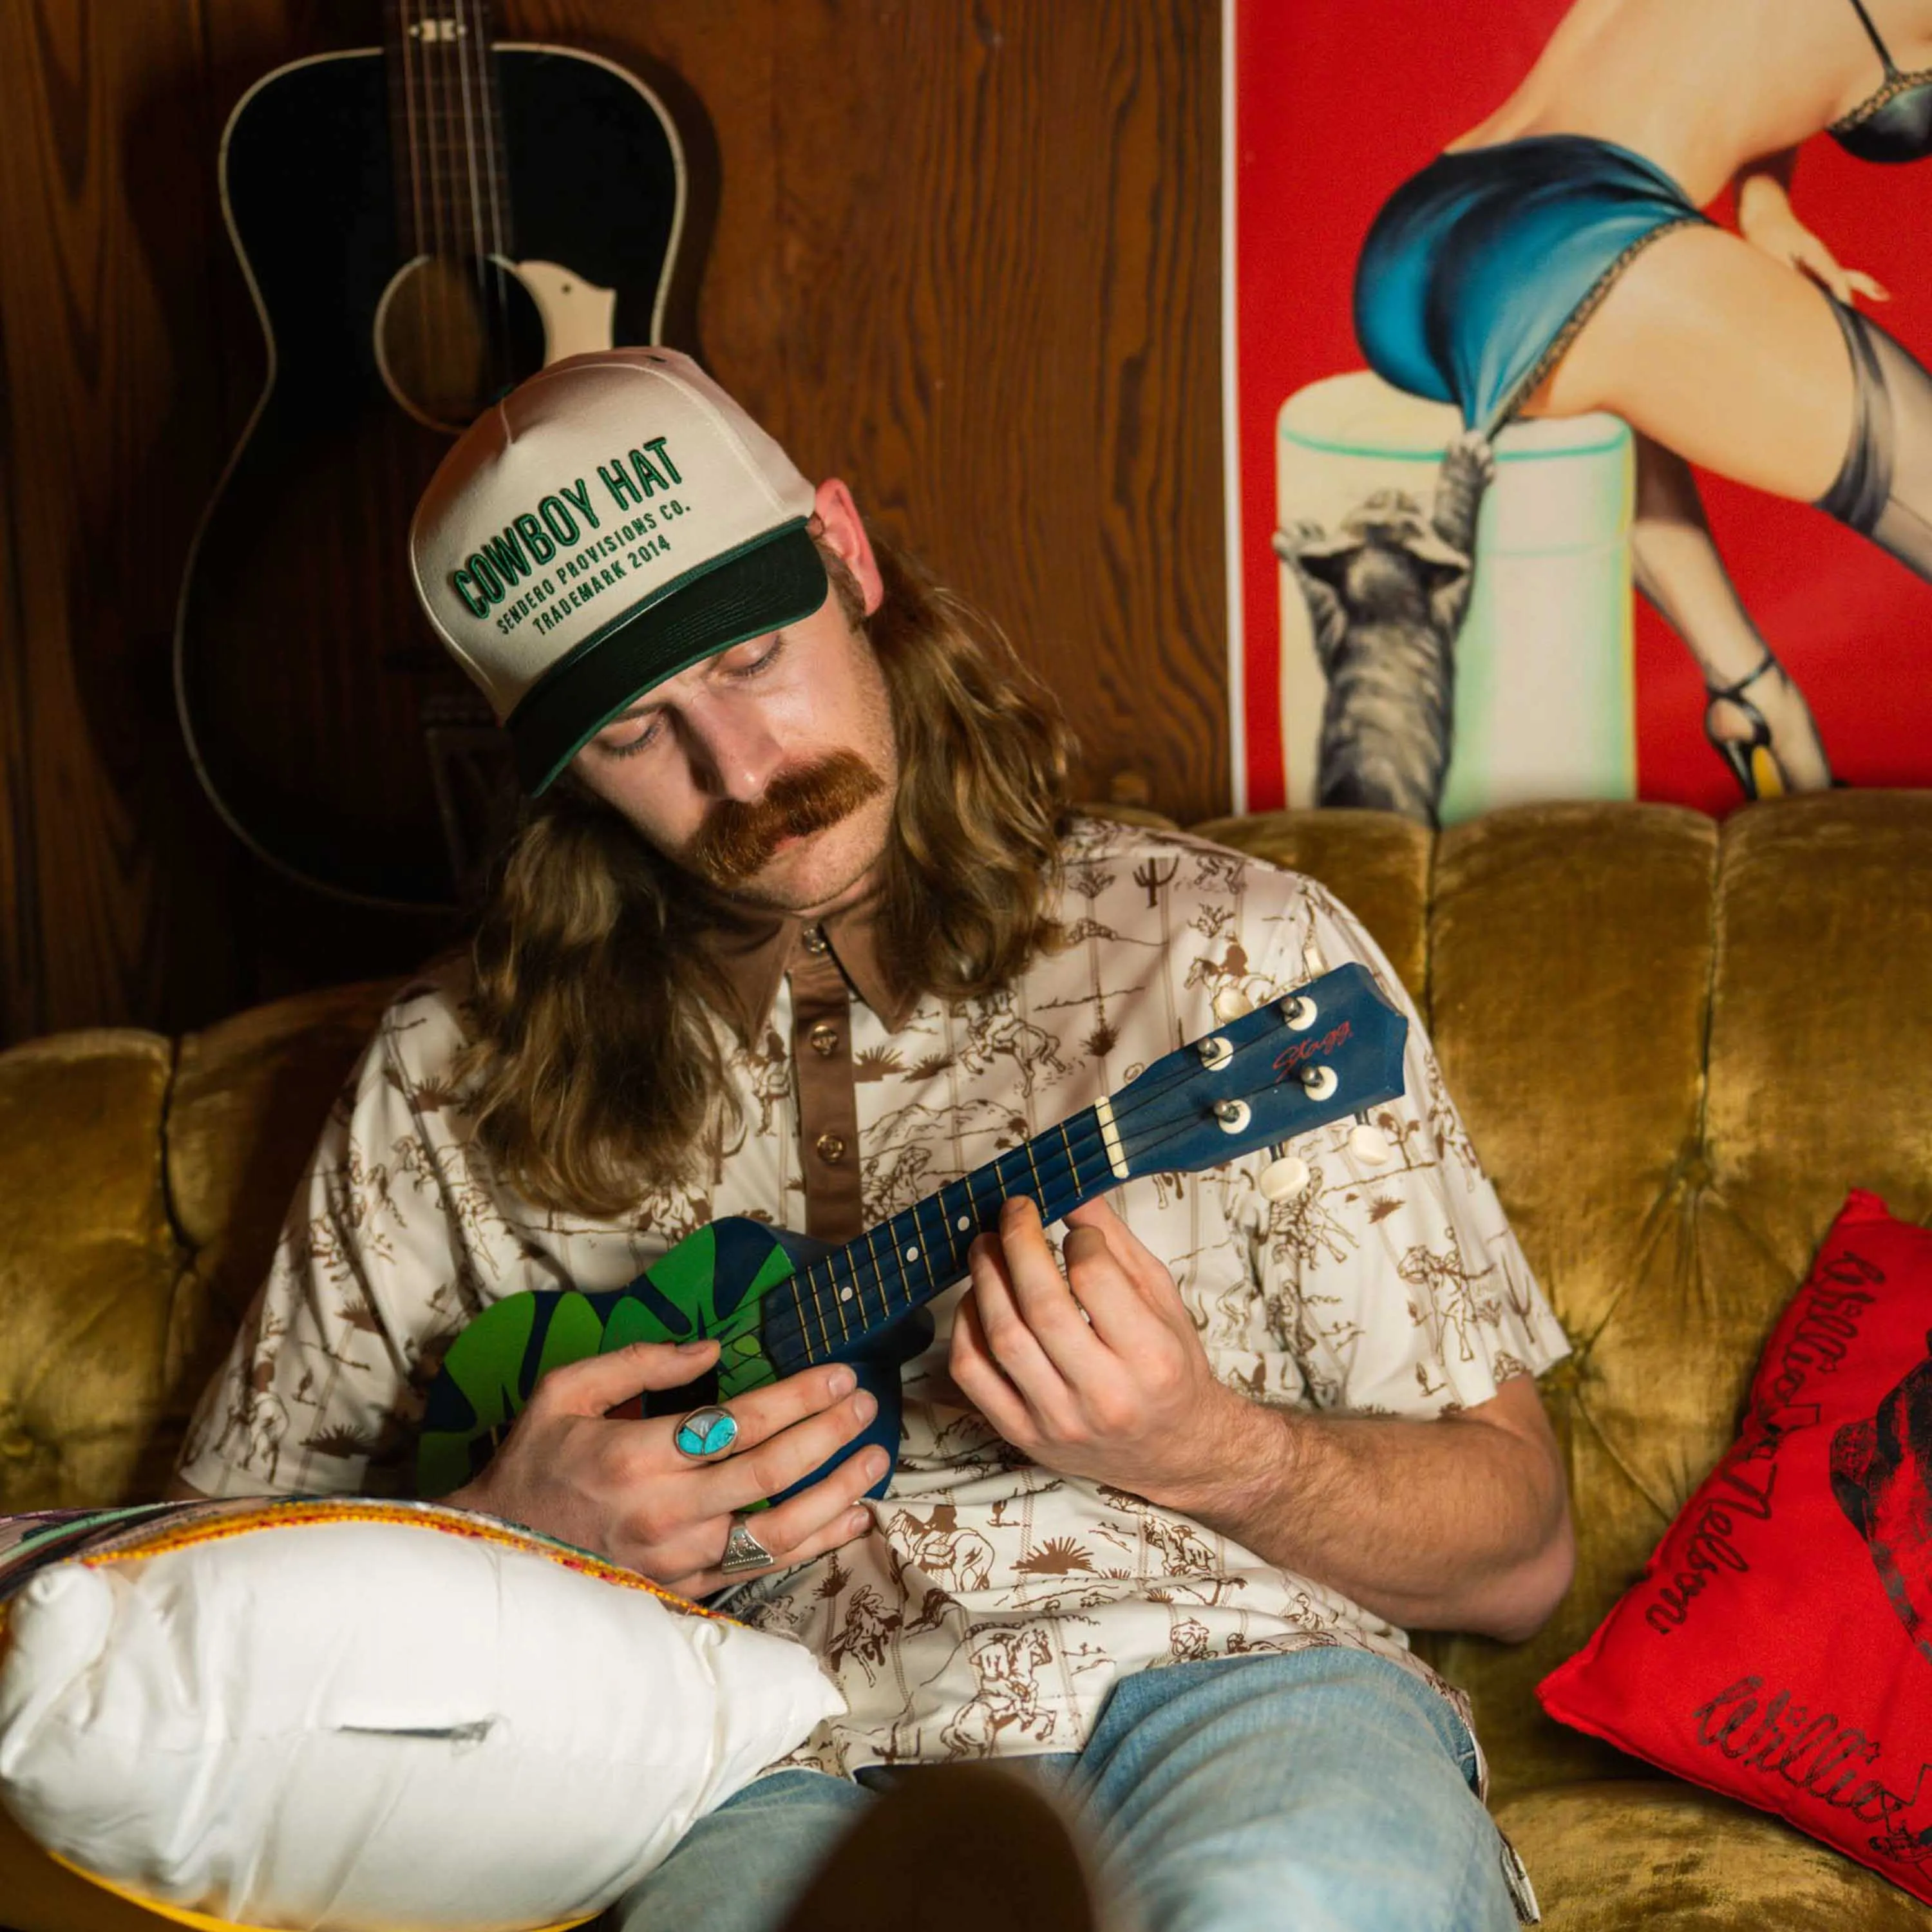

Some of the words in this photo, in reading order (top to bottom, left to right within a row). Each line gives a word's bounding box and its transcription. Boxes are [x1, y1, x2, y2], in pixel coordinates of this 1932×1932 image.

[453, 478, 600, 619] COWBOY
[597, 437, 682, 511] HAT
[497, 578, 555, 634] SENDERO
[556, 513, 657, 584] PROVISIONS
[659, 500, 691, 521] CO.
[533, 560, 627, 636] TRADEMARK
[627, 534, 671, 569] 2014
[1273, 1020, 1354, 1084] Stagg
[1645, 1462, 1778, 1635] Nelson
[1693, 1675, 1902, 1823] Willie
